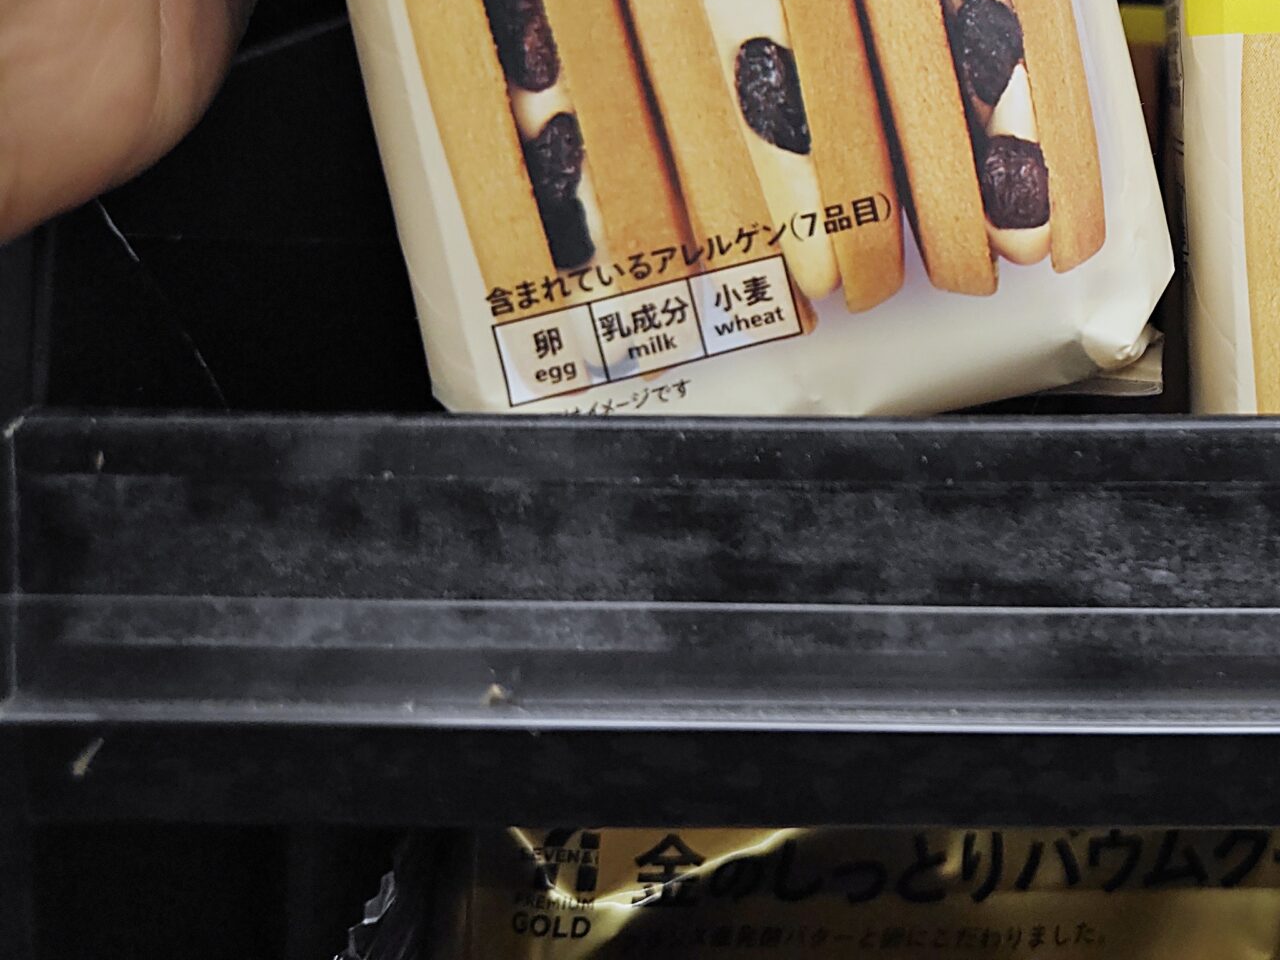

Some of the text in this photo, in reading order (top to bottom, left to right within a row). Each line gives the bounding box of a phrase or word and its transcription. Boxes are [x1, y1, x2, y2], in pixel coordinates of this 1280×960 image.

[714, 275, 775, 312] 小麦
[599, 297, 689, 343] 乳成分
[714, 307, 785, 337] wheat
[534, 327, 564, 358] 卵
[627, 334, 679, 361] milk
[534, 360, 578, 385] egg
[512, 911, 592, 939] GOLD
